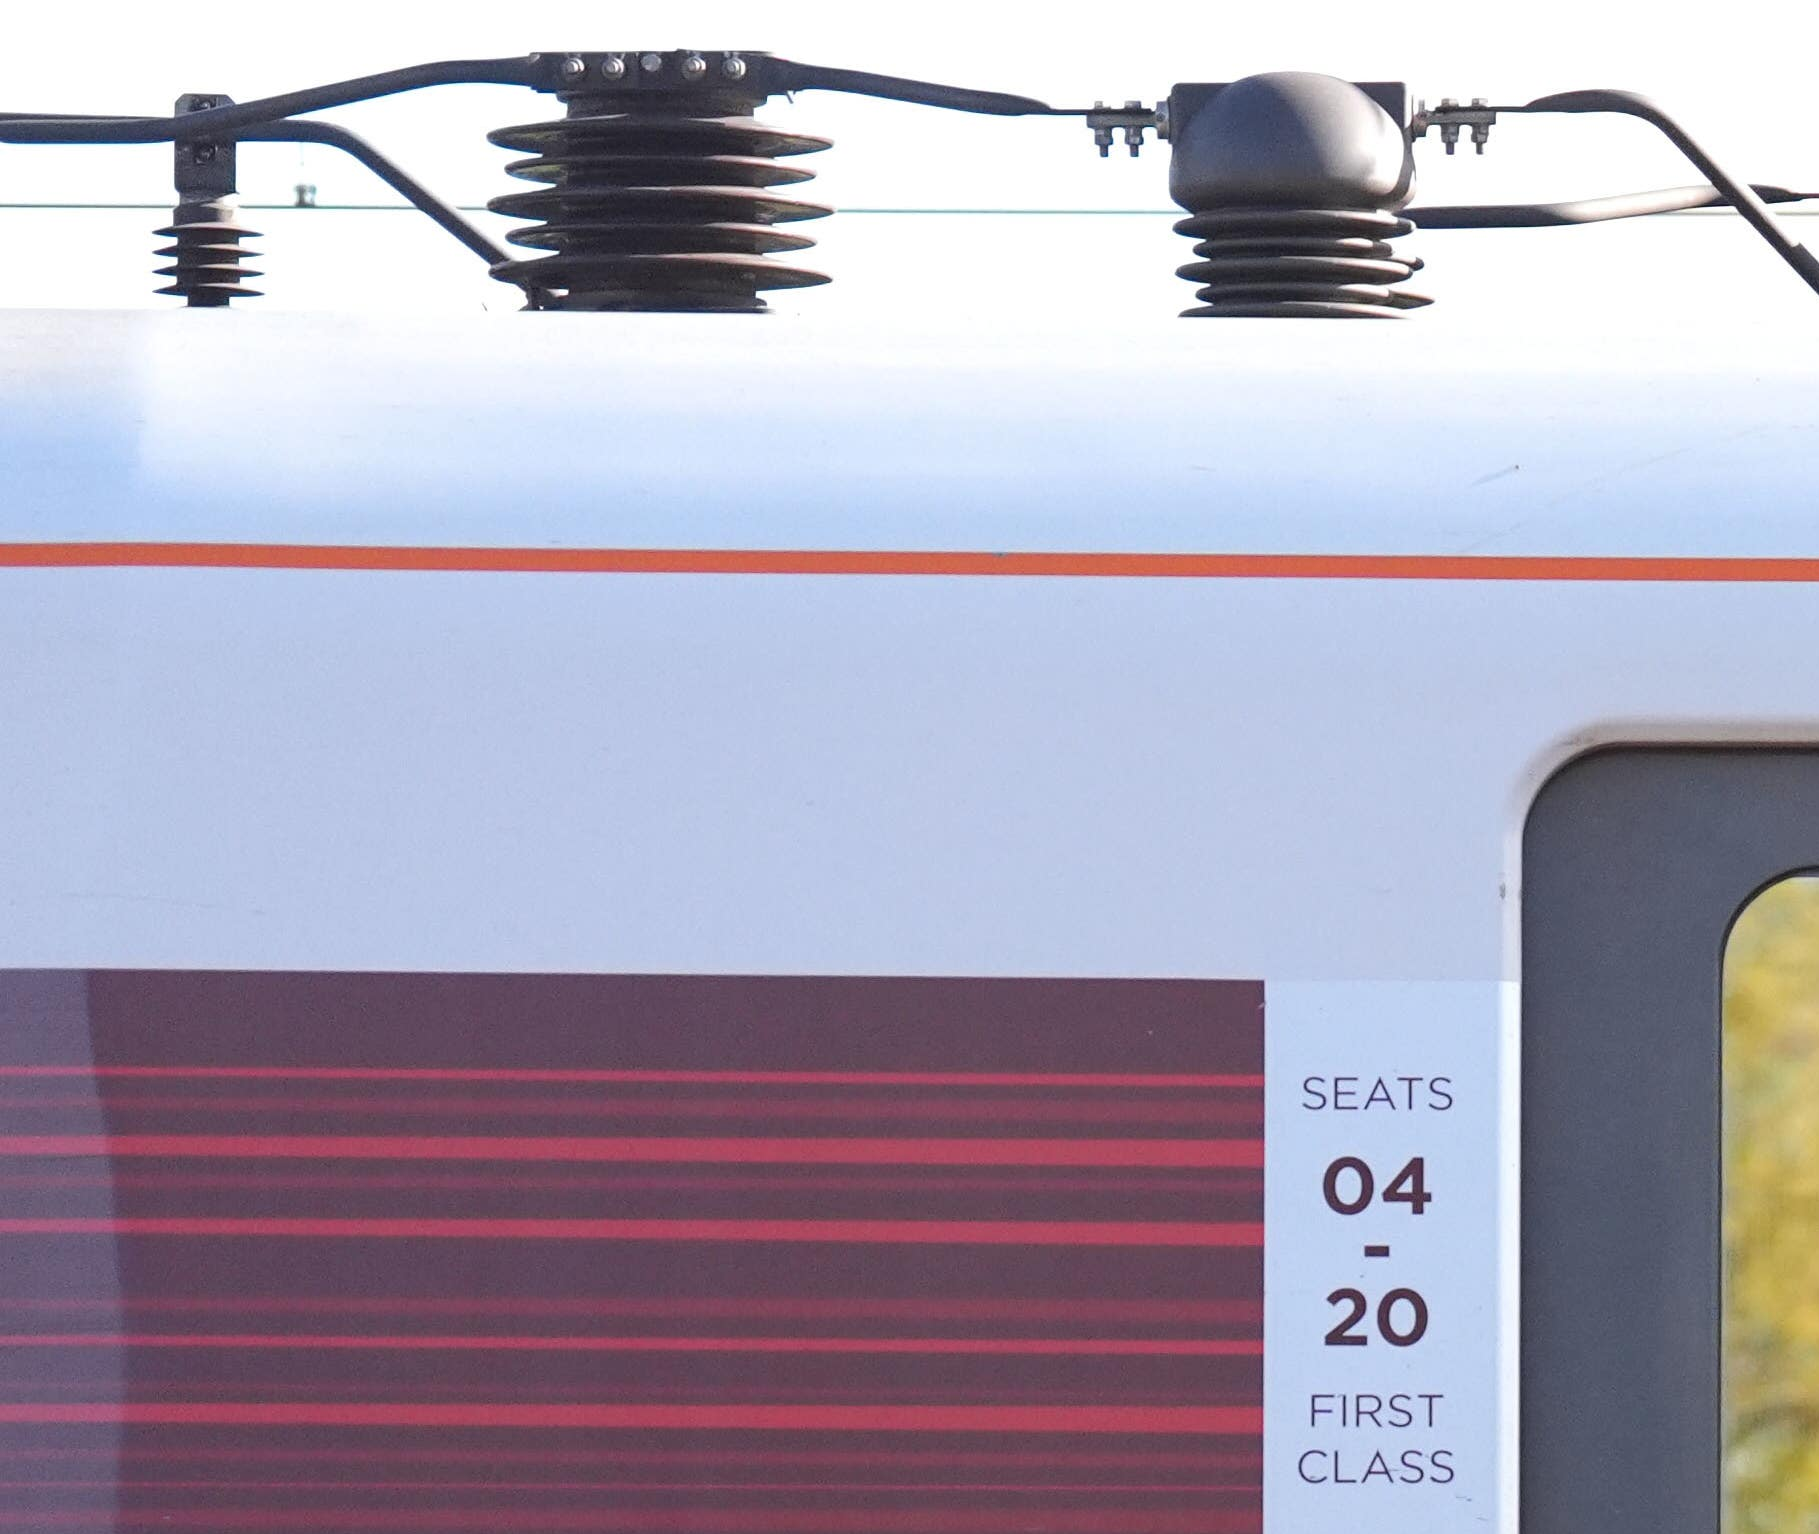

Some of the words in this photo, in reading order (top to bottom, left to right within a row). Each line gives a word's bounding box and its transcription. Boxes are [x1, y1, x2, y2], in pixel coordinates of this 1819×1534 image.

[1303, 1077, 1452, 1110] SEATS
[1323, 1157, 1431, 1215] 04
[1325, 1288, 1428, 1347] 20
[1312, 1395, 1443, 1427] FIRST
[1299, 1450, 1454, 1483] CLASS
